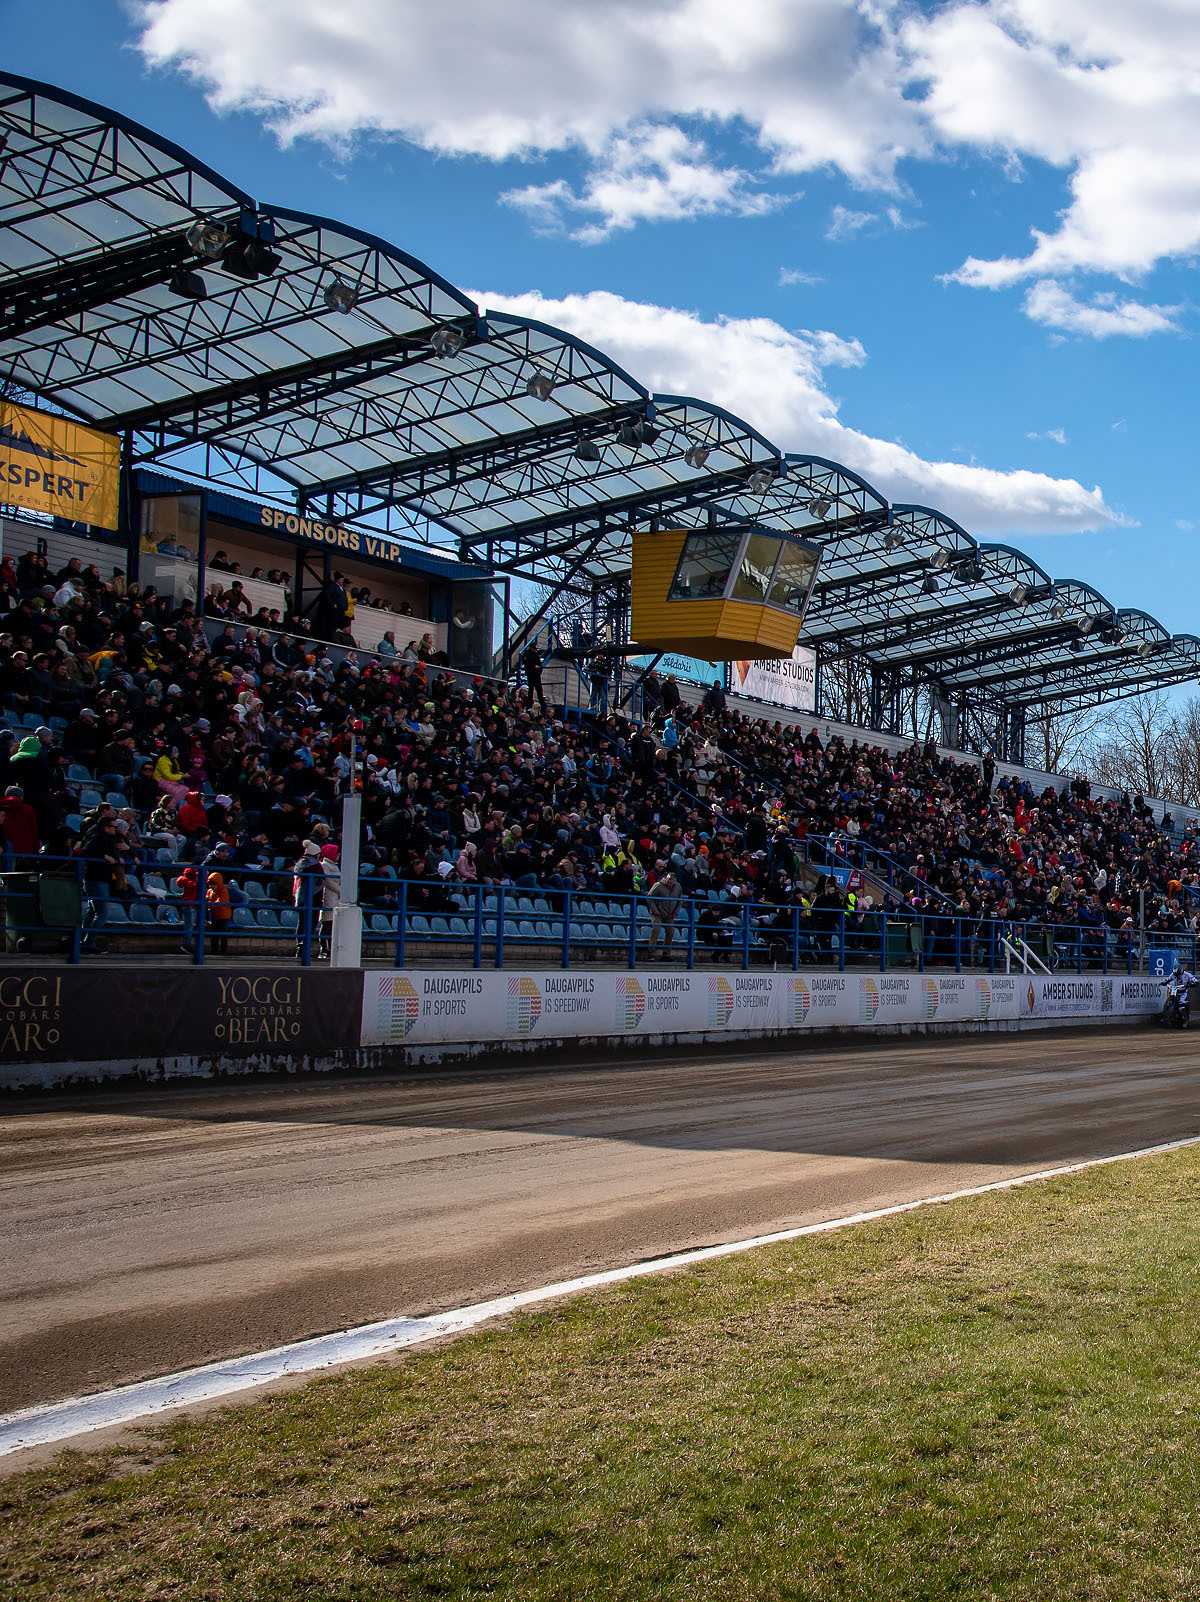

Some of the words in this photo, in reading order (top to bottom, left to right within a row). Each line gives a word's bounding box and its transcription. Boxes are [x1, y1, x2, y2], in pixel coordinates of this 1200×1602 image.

[260, 507, 360, 551] SPONSORS
[365, 537, 402, 563] V.I.P.
[753, 659, 781, 675] AMBER
[782, 661, 814, 683] STUDIOS
[217, 976, 302, 1004] YOGGI
[423, 978, 483, 994] DAUGAVPILS
[545, 978, 595, 993] DAUGAVPILS
[647, 978, 690, 992] DAUGAVPILS
[735, 978, 772, 991] DAUGAVPILS
[811, 979, 845, 991] DAUGAVPILS
[880, 979, 909, 990] DAUGAVPILS
[939, 979, 965, 990] DAUGAVPILS
[1043, 983, 1066, 999] AMBER
[1067, 983, 1094, 999] STUDIOS
[1120, 983, 1139, 999] AMBER
[423, 1000, 431, 1015] IR
[434, 1000, 467, 1015] SPORTS
[545, 998, 552, 1013] IS
[554, 998, 591, 1013] SPEEDWAY
[647, 997, 654, 1010] IR
[655, 997, 679, 1010] SPORTS
[735, 995, 741, 1008] IS
[742, 995, 769, 1008] SPEEDWAY
[229, 1017, 291, 1044] BEAR
